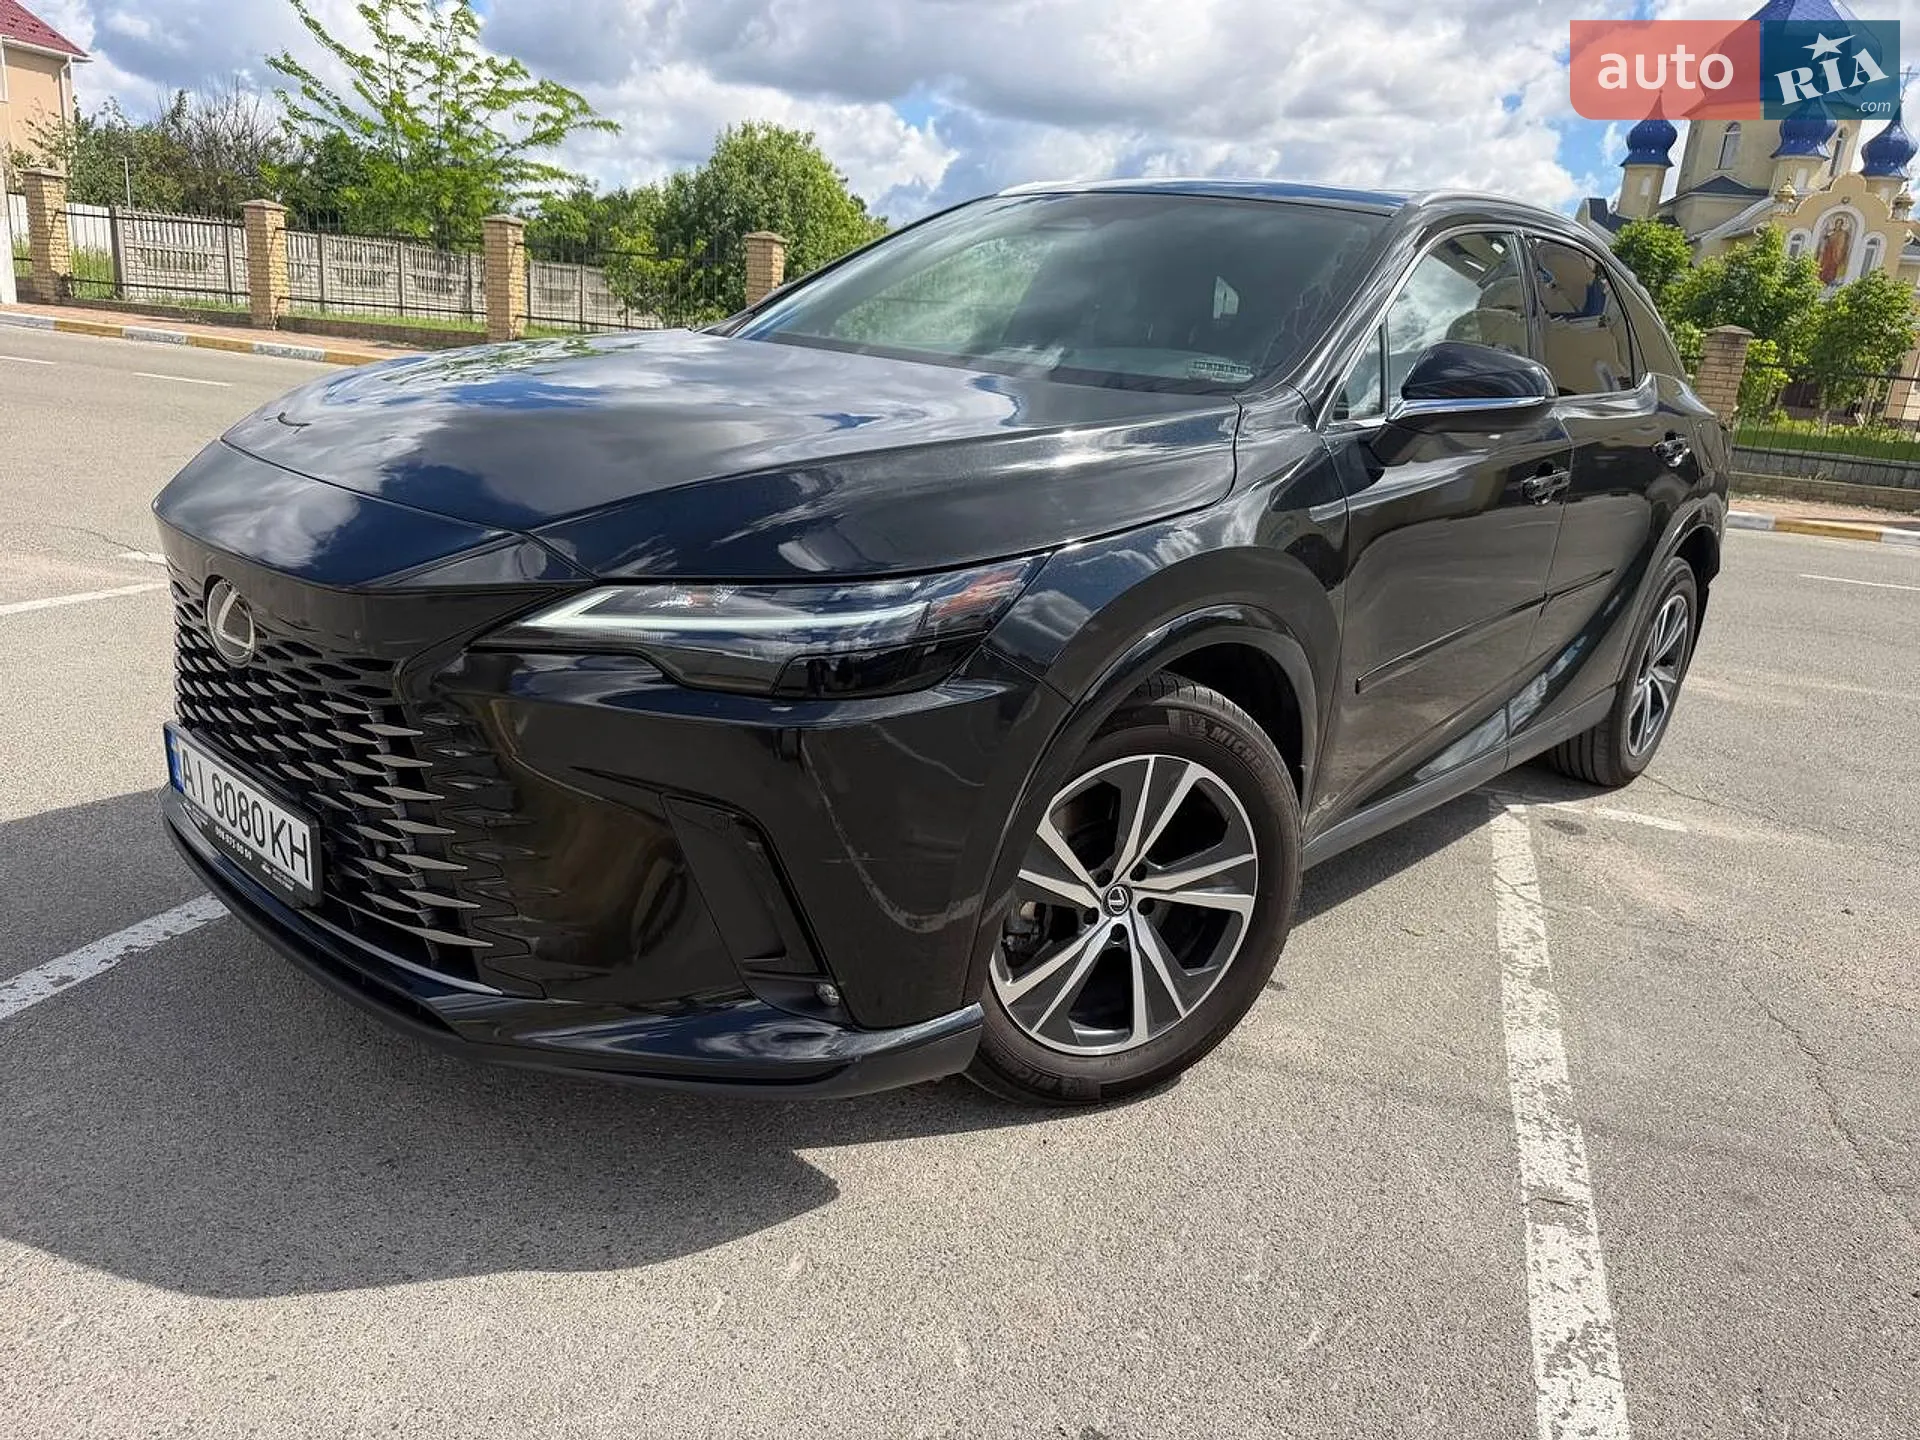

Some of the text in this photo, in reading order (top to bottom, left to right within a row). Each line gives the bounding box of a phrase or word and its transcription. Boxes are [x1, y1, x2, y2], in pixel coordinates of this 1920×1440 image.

[183, 749, 206, 805] AI
[211, 773, 266, 848] 8080
[268, 810, 310, 881] KH
